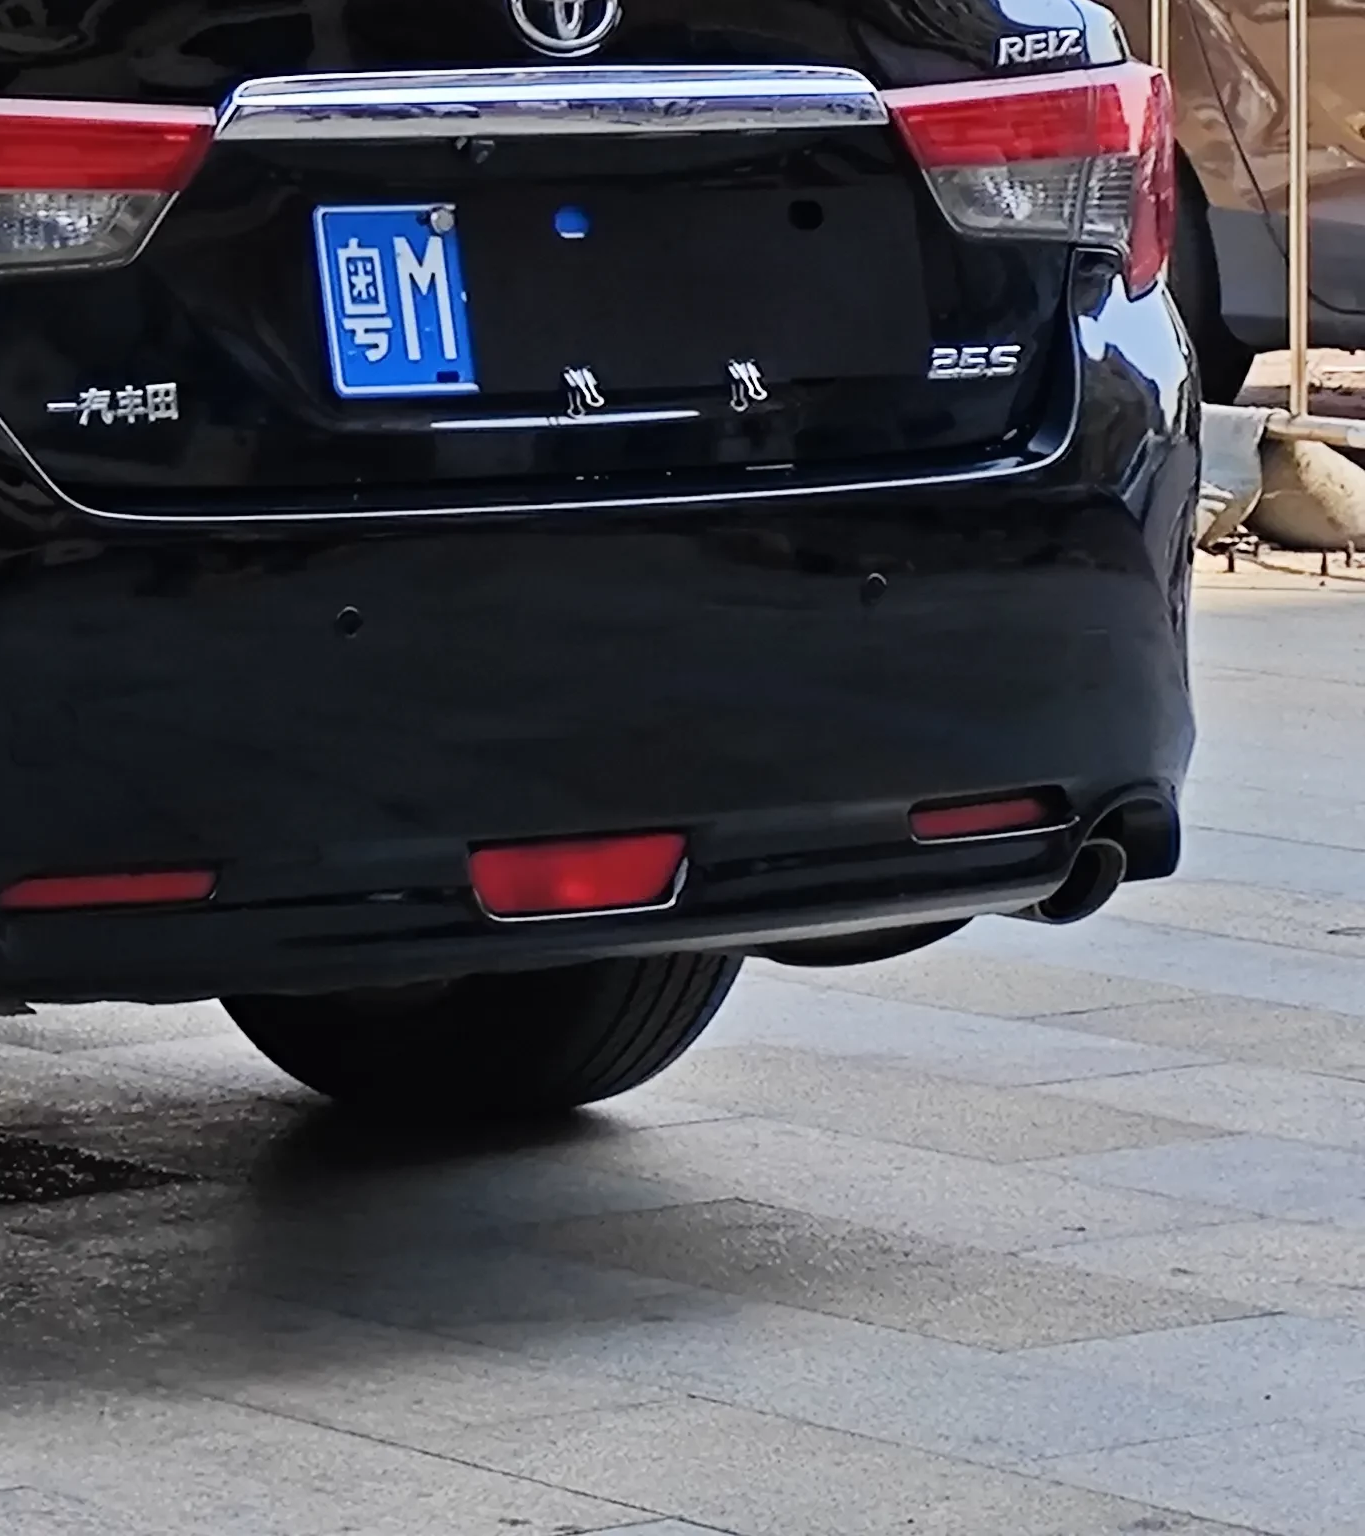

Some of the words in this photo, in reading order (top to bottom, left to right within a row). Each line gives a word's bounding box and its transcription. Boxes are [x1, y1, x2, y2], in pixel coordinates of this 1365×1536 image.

[997, 29, 1083, 67] REIZ
[336, 235, 458, 362] 粤M
[46, 382, 179, 426] 一汽丰田
